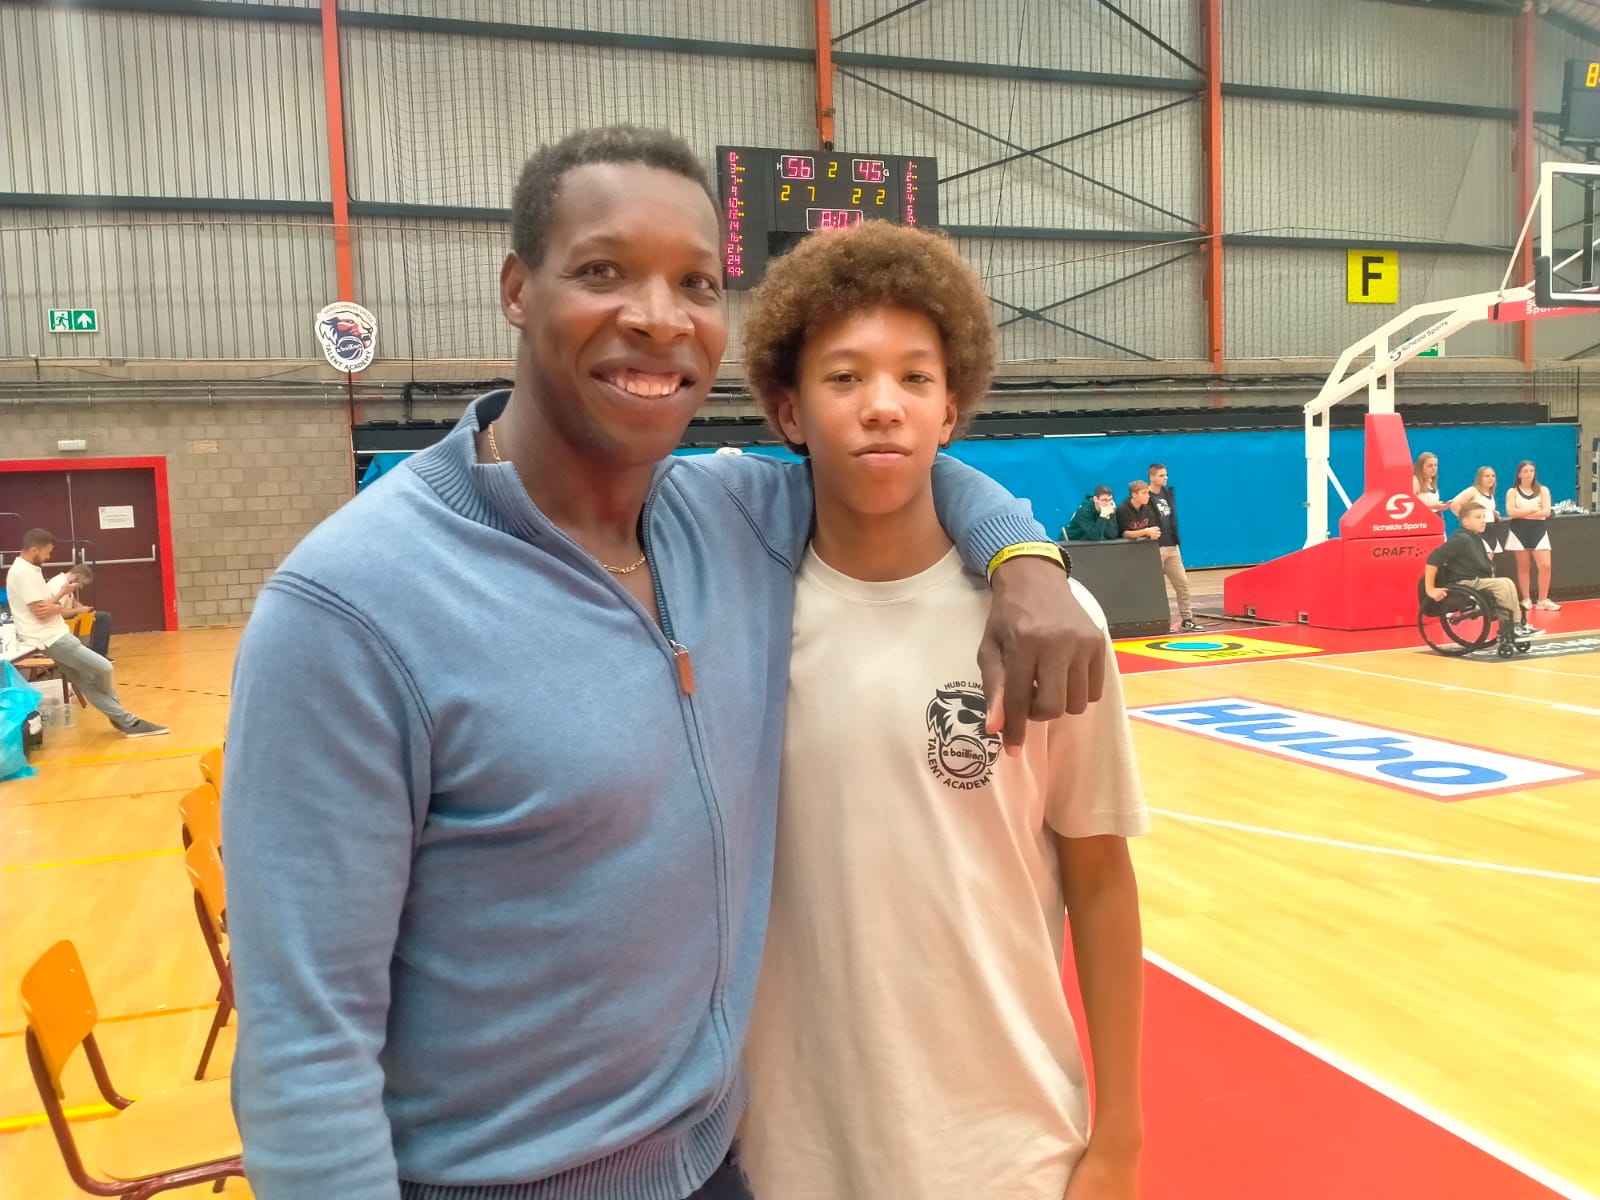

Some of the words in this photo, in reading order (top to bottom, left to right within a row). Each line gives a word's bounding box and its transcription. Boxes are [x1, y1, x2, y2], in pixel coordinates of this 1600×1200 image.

[1586, 62, 1599, 87] 8
[787, 158, 811, 178] 56
[828, 161, 838, 178] 2
[859, 161, 882, 181] 45
[730, 175, 737, 185] 7
[781, 184, 791, 202] 2
[807, 185, 816, 202] 7
[852, 188, 862, 205] 2
[876, 189, 886, 206] 2
[1361, 255, 1385, 297] F
[325, 344, 343, 367] TALENT
[343, 350, 372, 370] ACADEMY
[1403, 522, 1428, 532] Sports
[1372, 545, 1415, 558] CRAFT
[944, 680, 967, 690] HUBO
[967, 681, 984, 691] LIM
[1145, 703, 1508, 785] Hubo
[927, 736, 944, 779] TALENT
[943, 768, 994, 790] ACADEMY
